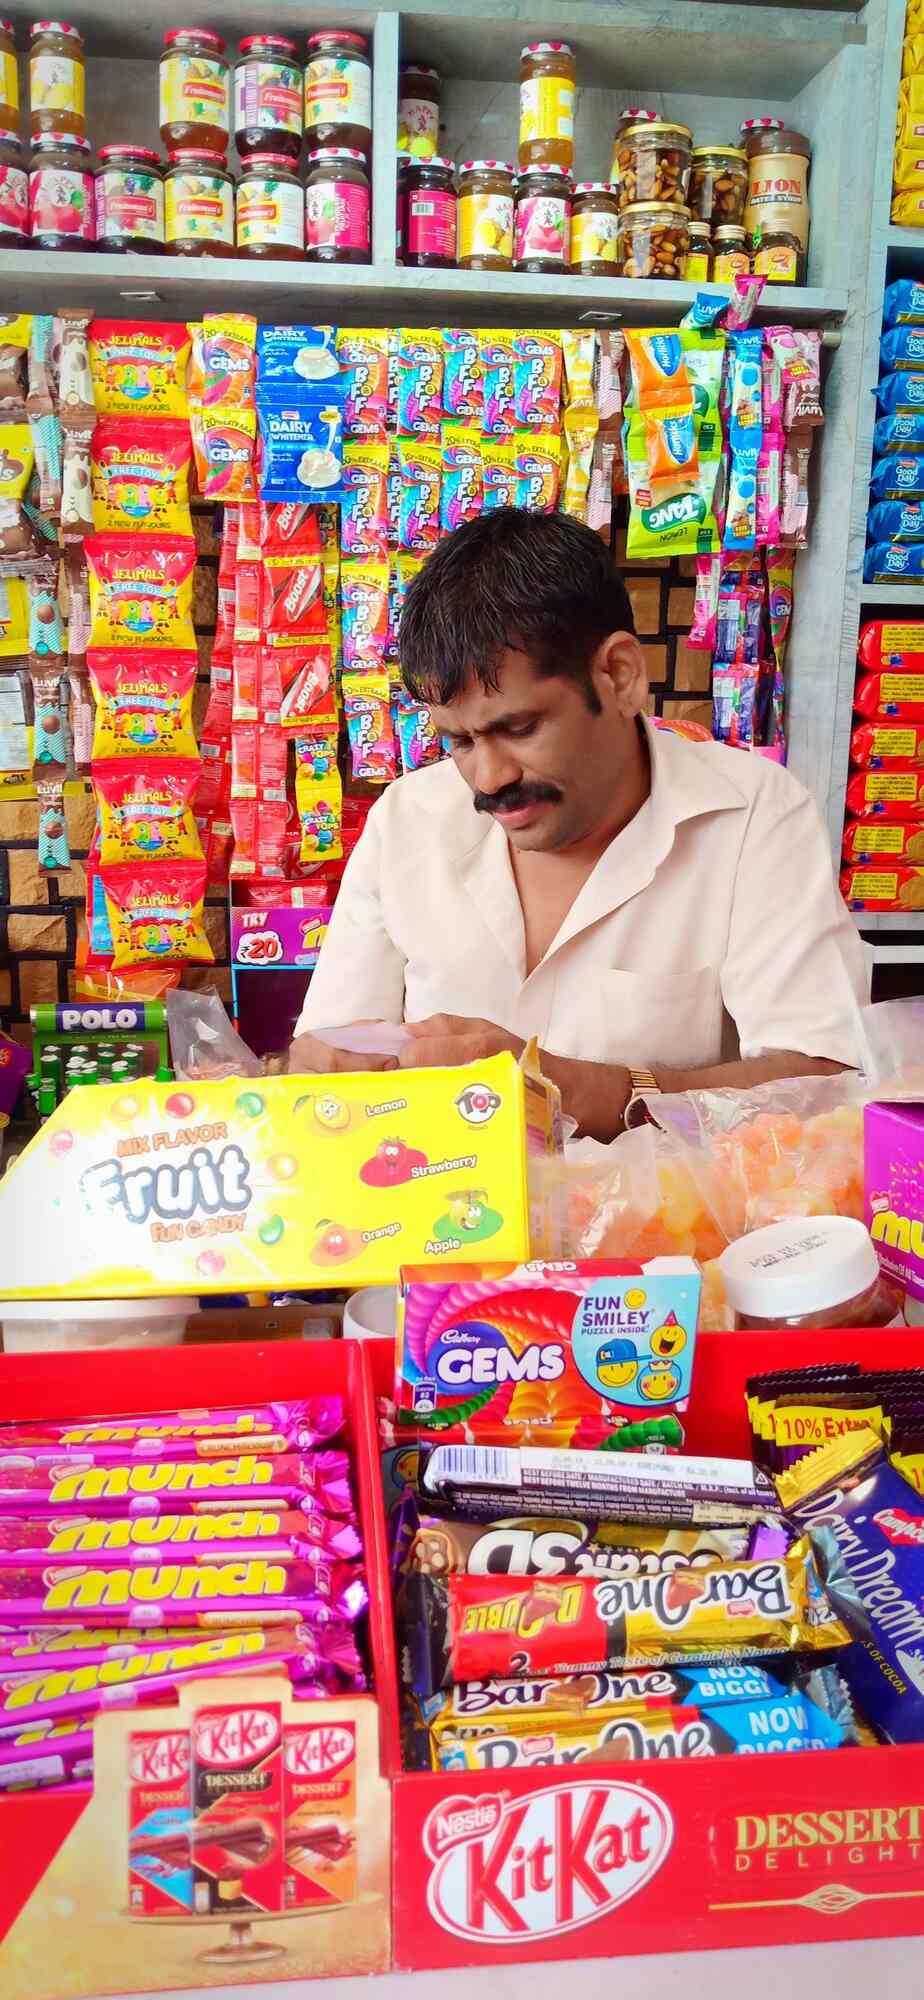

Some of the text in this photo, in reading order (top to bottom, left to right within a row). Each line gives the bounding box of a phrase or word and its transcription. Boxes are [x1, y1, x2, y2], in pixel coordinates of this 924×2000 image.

[751, 178, 801, 195] LION
[208, 356, 249, 371] GEMS
[492, 353, 513, 363] GEM
[269, 421, 312, 433] DAIRY
[493, 424, 514, 434] GEM
[894, 417, 915, 428] Good
[209, 448, 249, 463] GEMS
[896, 465, 918, 477] Good
[897, 474, 915, 485] Day
[901, 511, 923, 522] Good
[886, 551, 908, 563] Good
[241, 912, 269, 928] TRY
[62, 1007, 139, 1031] POLO
[366, 1097, 408, 1118] Lemon
[152, 1122, 228, 1151] FLAVOR
[410, 1154, 478, 1180] Strawberry
[80, 1144, 252, 1224] Fruit
[362, 1221, 402, 1243] Orange
[424, 1236, 463, 1255] Apple
[583, 1296, 621, 1312] FUN
[582, 1311, 650, 1327] SMILEY
[581, 1327, 614, 1336] PUZZLE
[437, 1345, 565, 1385] GEMS
[783, 1417, 822, 1440] 10%
[49, 1454, 274, 1503] munch
[47, 1510, 281, 1554] munch
[42, 1560, 288, 1612] munch
[600, 1564, 793, 1626] Bar One
[4, 1632, 266, 1711] munch
[879, 1662, 909, 1696] COCOA
[458, 1681, 556, 1713] Bar
[700, 1679, 770, 1697] BIGG
[209, 1712, 270, 1761] KitKat
[141, 1736, 191, 1780] KitKa
[292, 1728, 347, 1773] KitKat
[205, 1771, 268, 1788] DESSERT
[736, 1805, 924, 1851] DESSERT
[464, 1788, 652, 1933] KitKat
